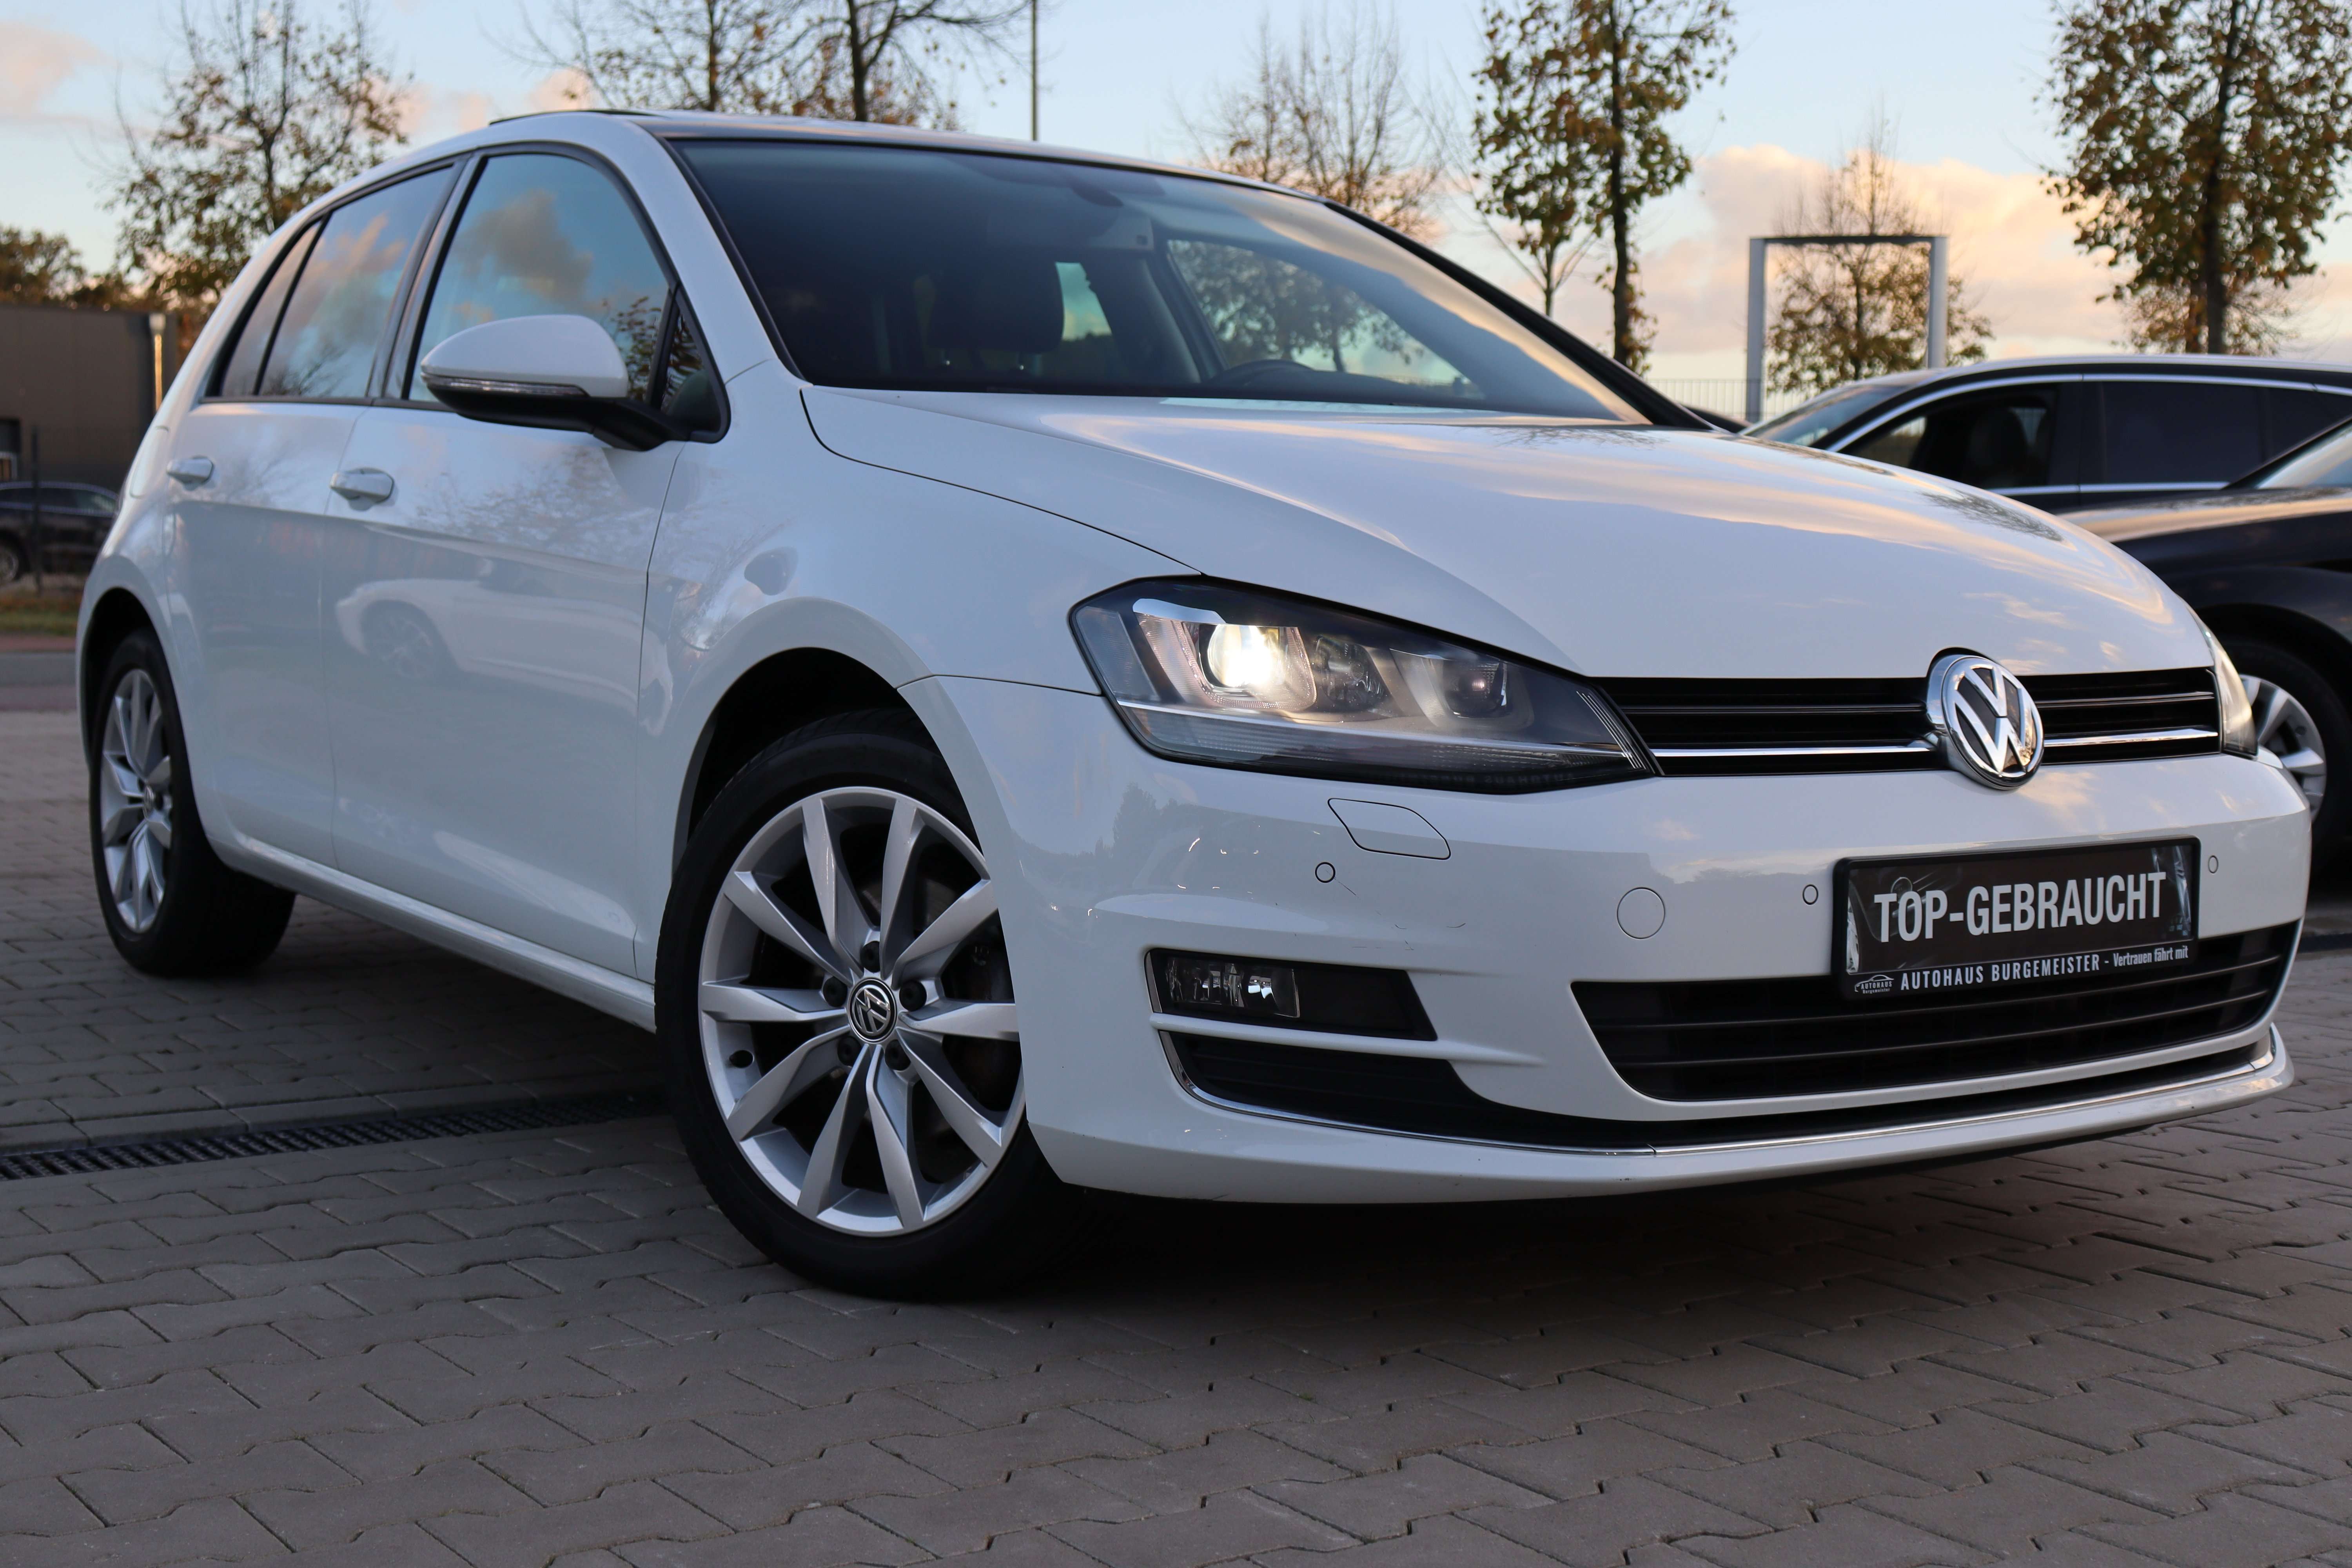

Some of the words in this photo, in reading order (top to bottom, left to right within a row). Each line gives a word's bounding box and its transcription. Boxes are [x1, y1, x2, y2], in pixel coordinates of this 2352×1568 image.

[1874, 872, 2166, 942] TOP-GEBRAUCHT
[1861, 981, 1892, 989] AUTOHAUS
[1901, 966, 1983, 990] AUTOHAUS
[1992, 954, 2099, 981] BURGEMEISTER
[2113, 953, 2152, 967] Vertrauen
[2154, 947, 2173, 962] fährt
[2176, 945, 2188, 959] mit
